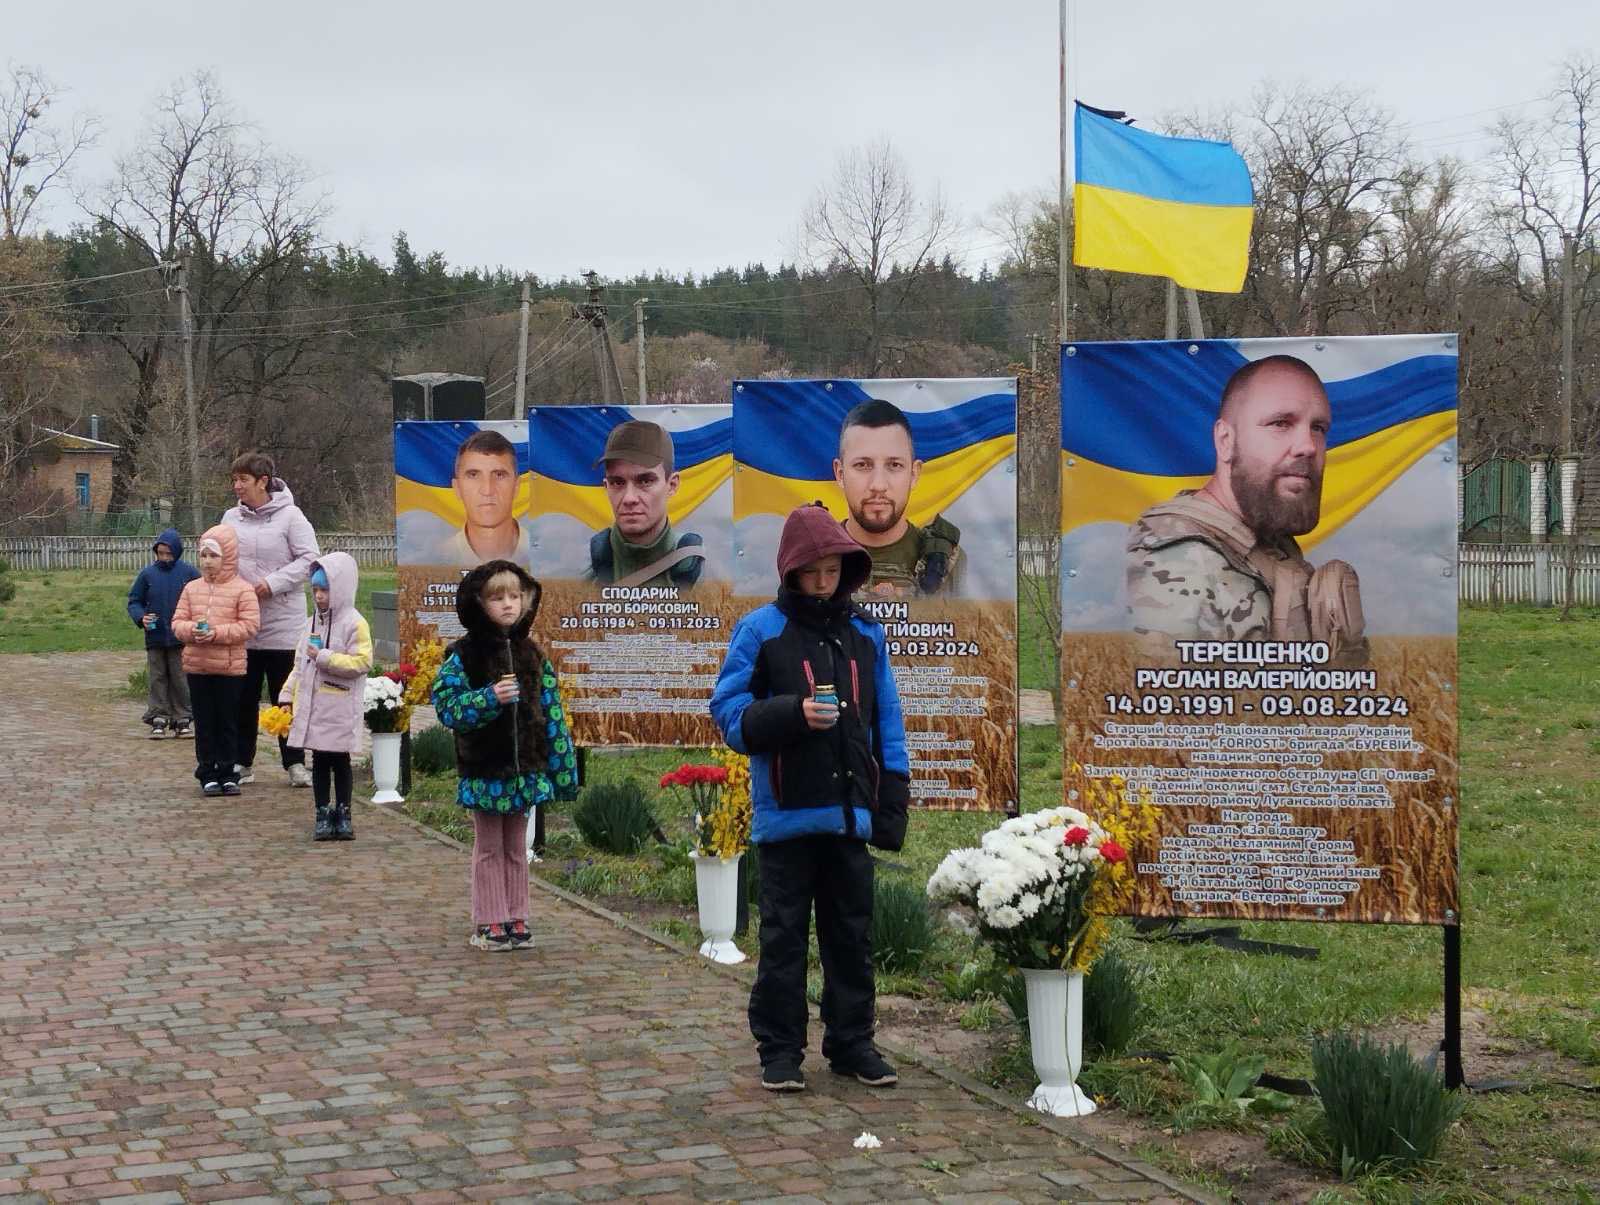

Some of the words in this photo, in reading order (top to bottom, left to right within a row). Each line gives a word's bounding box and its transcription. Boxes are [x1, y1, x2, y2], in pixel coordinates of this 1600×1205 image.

[428, 584, 460, 593] СТАН
[601, 587, 679, 601] СПОДАРИК
[423, 596, 457, 606] 15.11.1
[581, 603, 622, 614] ПЕТРО
[624, 603, 699, 614] БОРИСОВИЧ
[561, 617, 635, 629] 20.06.1984
[649, 617, 720, 629] 09.11.2023
[884, 619, 955, 637] ГІЙОВИЧ
[1176, 640, 1330, 667] ТЕРЕЩЕНКО
[1136, 669, 1221, 689] РУСЛАН
[1223, 666, 1377, 690] ВАЛЕРІЙОВИЧ
[1104, 694, 1235, 716] 14.09.1991
[1260, 696, 1409, 717] 09.08.2024
[1105, 722, 1164, 738] Старший
[1166, 725, 1212, 737] солдат
[1215, 724, 1305, 738] Національної
[1308, 726, 1357, 739] гвардії
[1358, 727, 1413, 740] України
[1105, 739, 1137, 750] рота
[1139, 736, 1210, 750] батальйон
[1289, 739, 1346, 752] бригада
[1191, 751, 1324, 766] навідник-оператор
[1084, 765, 1139, 779] Загинув
[1140, 766, 1162, 780] під
[1163, 768, 1190, 779] час
[1189, 768, 1276, 780] мінометного
[1279, 769, 1339, 783] обстрілу
[1341, 770, 1358, 781] на
[1359, 770, 1378, 781] СП
[1139, 780, 1204, 794] південній
[1205, 781, 1260, 795] околиці
[1123, 792, 1210, 806] Свівського
[1211, 794, 1260, 807] району
[1261, 795, 1340, 808] Луганської
[1190, 825, 1240, 836] медаль
[1268, 825, 1326, 838] відвагу»
[1162, 838, 1214, 850] медаль
[1216, 839, 1301, 851] «Незламним
[1303, 841, 1353, 853] Героям
[1311, 854, 1357, 865] війни»
[1138, 864, 1193, 876] почесна
[1196, 866, 1259, 879] нагорода
[1272, 867, 1345, 879] нагрудний
[1346, 868, 1381, 879] знак
[1190, 877, 1263, 889] батальйон
[1263, 881, 1284, 891] ОП
[1285, 881, 1361, 893] «Форпост»
[1173, 890, 1232, 902] відзнака
[1234, 891, 1298, 904] «Ветеран
[1299, 892, 1346, 905] війни»
